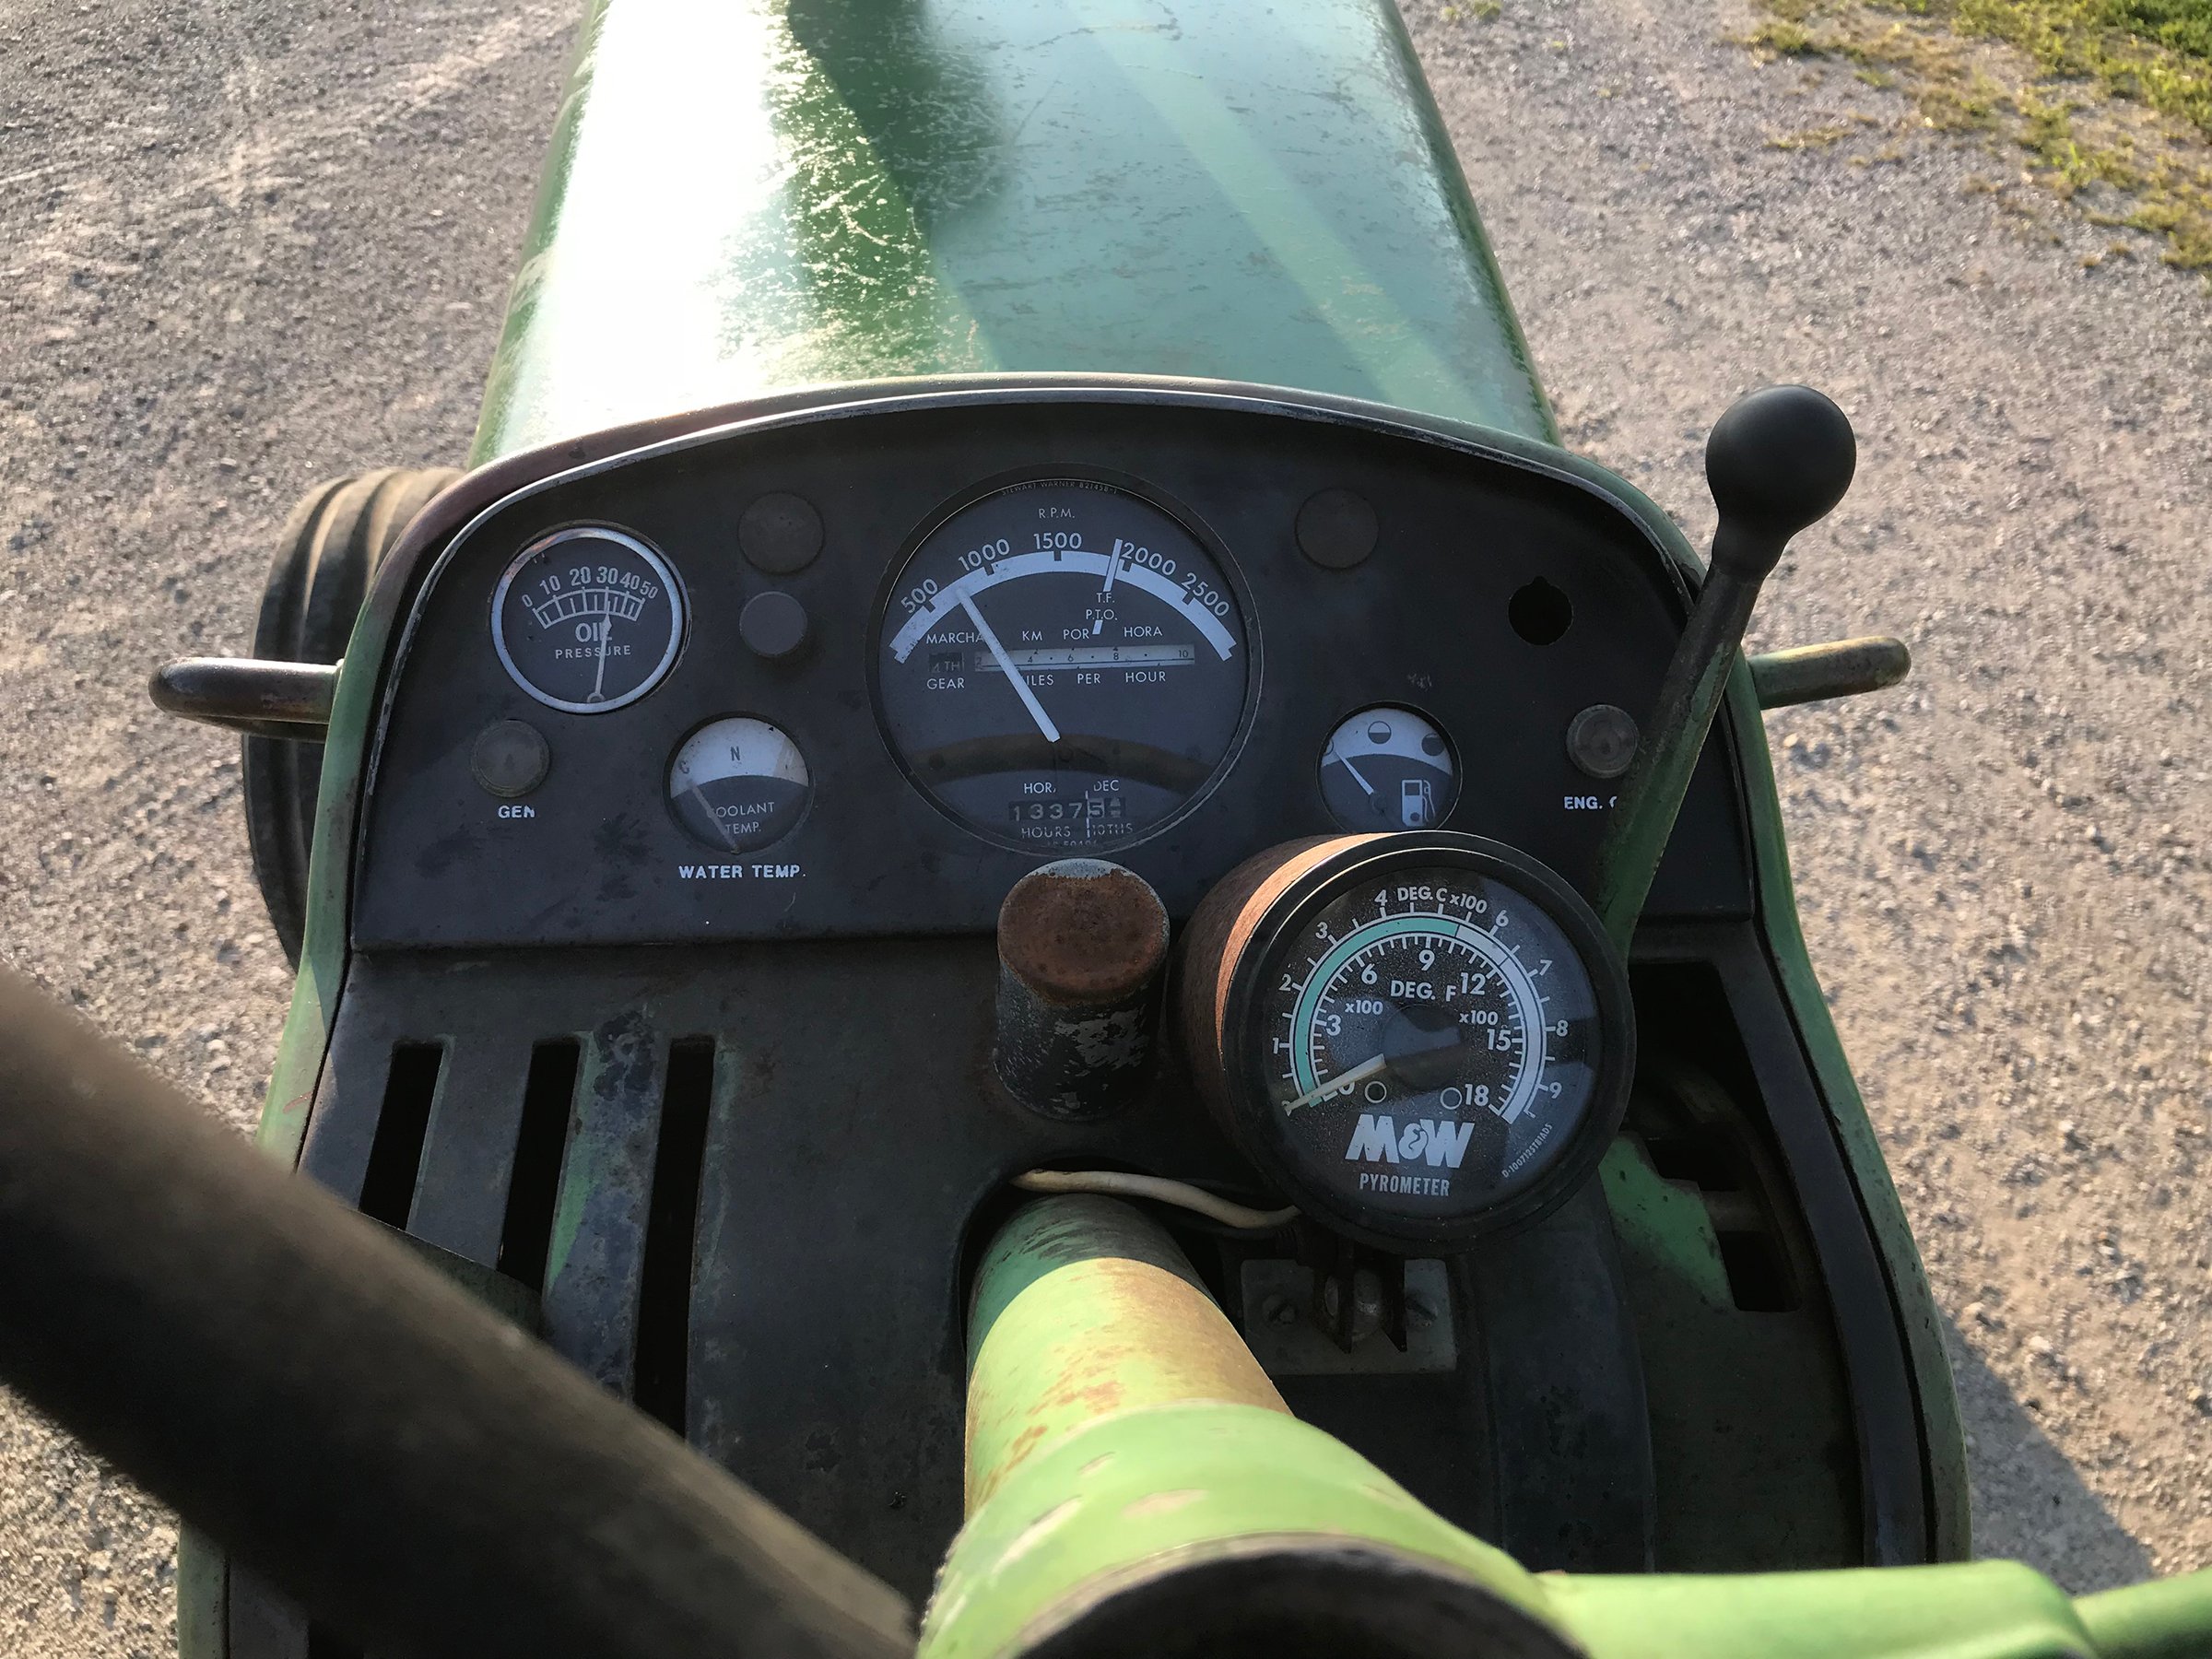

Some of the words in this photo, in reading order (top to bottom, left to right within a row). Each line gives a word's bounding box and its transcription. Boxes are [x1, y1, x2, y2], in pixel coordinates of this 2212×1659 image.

[1001, 482, 1037, 496] STEWART
[1040, 480, 1076, 488] WARNER
[1038, 507, 1076, 519] R.P.M.
[900, 578, 938, 615] 500
[958, 538, 1011, 571] 1000
[1033, 533, 1082, 550] 1500
[1123, 542, 1176, 577] 2000
[1181, 572, 1230, 618] 2500
[522, 594, 534, 607] 0
[539, 575, 561, 595] 10
[570, 566, 591, 586] 20
[596, 566, 618, 584] 30
[619, 571, 641, 590] 40
[640, 582, 659, 599] 50
[1097, 592, 1116, 603] T.F.
[1085, 609, 1118, 621] P.T.O.
[925, 631, 985, 644] MARCHA
[1022, 630, 1042, 641] KM
[1063, 629, 1089, 640] POR
[1124, 626, 1163, 638] HORA
[555, 644, 632, 660] PRESSURE
[1067, 653, 1075, 663] 6
[1112, 652, 1120, 661] 8
[1178, 649, 1189, 658] 10
[926, 677, 965, 689] GEAR
[1024, 674, 1054, 687] ILES
[1077, 673, 1101, 685] PER
[1125, 670, 1166, 683] HOUR
[730, 746, 741, 762] N
[1093, 780, 1120, 792] DEC
[498, 805, 535, 818] GEN
[1563, 796, 1604, 810] ENG.
[725, 821, 761, 835] TEMP.
[1021, 826, 1071, 840] HOURS
[678, 865, 743, 879] WATER
[751, 865, 807, 878] TEMP.
[1374, 889, 1388, 907] 4
[1397, 887, 1433, 902] DEG.
[1435, 888, 1448, 903] C
[1449, 889, 1488, 914] x100
[1495, 910, 1509, 927] 6
[1316, 923, 1328, 939] 3
[1418, 949, 1435, 971] 9
[1539, 959, 1553, 976] 7
[1278, 973, 1292, 991] 2
[1360, 963, 1377, 985] 6
[1390, 980, 1436, 1001] DEG.
[1444, 983, 1457, 1002] F
[1460, 972, 1487, 996] 12
[1345, 1000, 1383, 1016] x100
[1325, 1014, 1342, 1036] 3
[1459, 1010, 1498, 1026] x100
[1555, 1019, 1569, 1037] 8
[1272, 1037, 1279, 1054] 1
[1487, 1028, 1512, 1051] 15
[1464, 1083, 1489, 1106] 18
[1548, 1081, 1563, 1099] 9
[1344, 1113, 1475, 1169] M&W
[1359, 1172, 1450, 1196] PYROMETER
